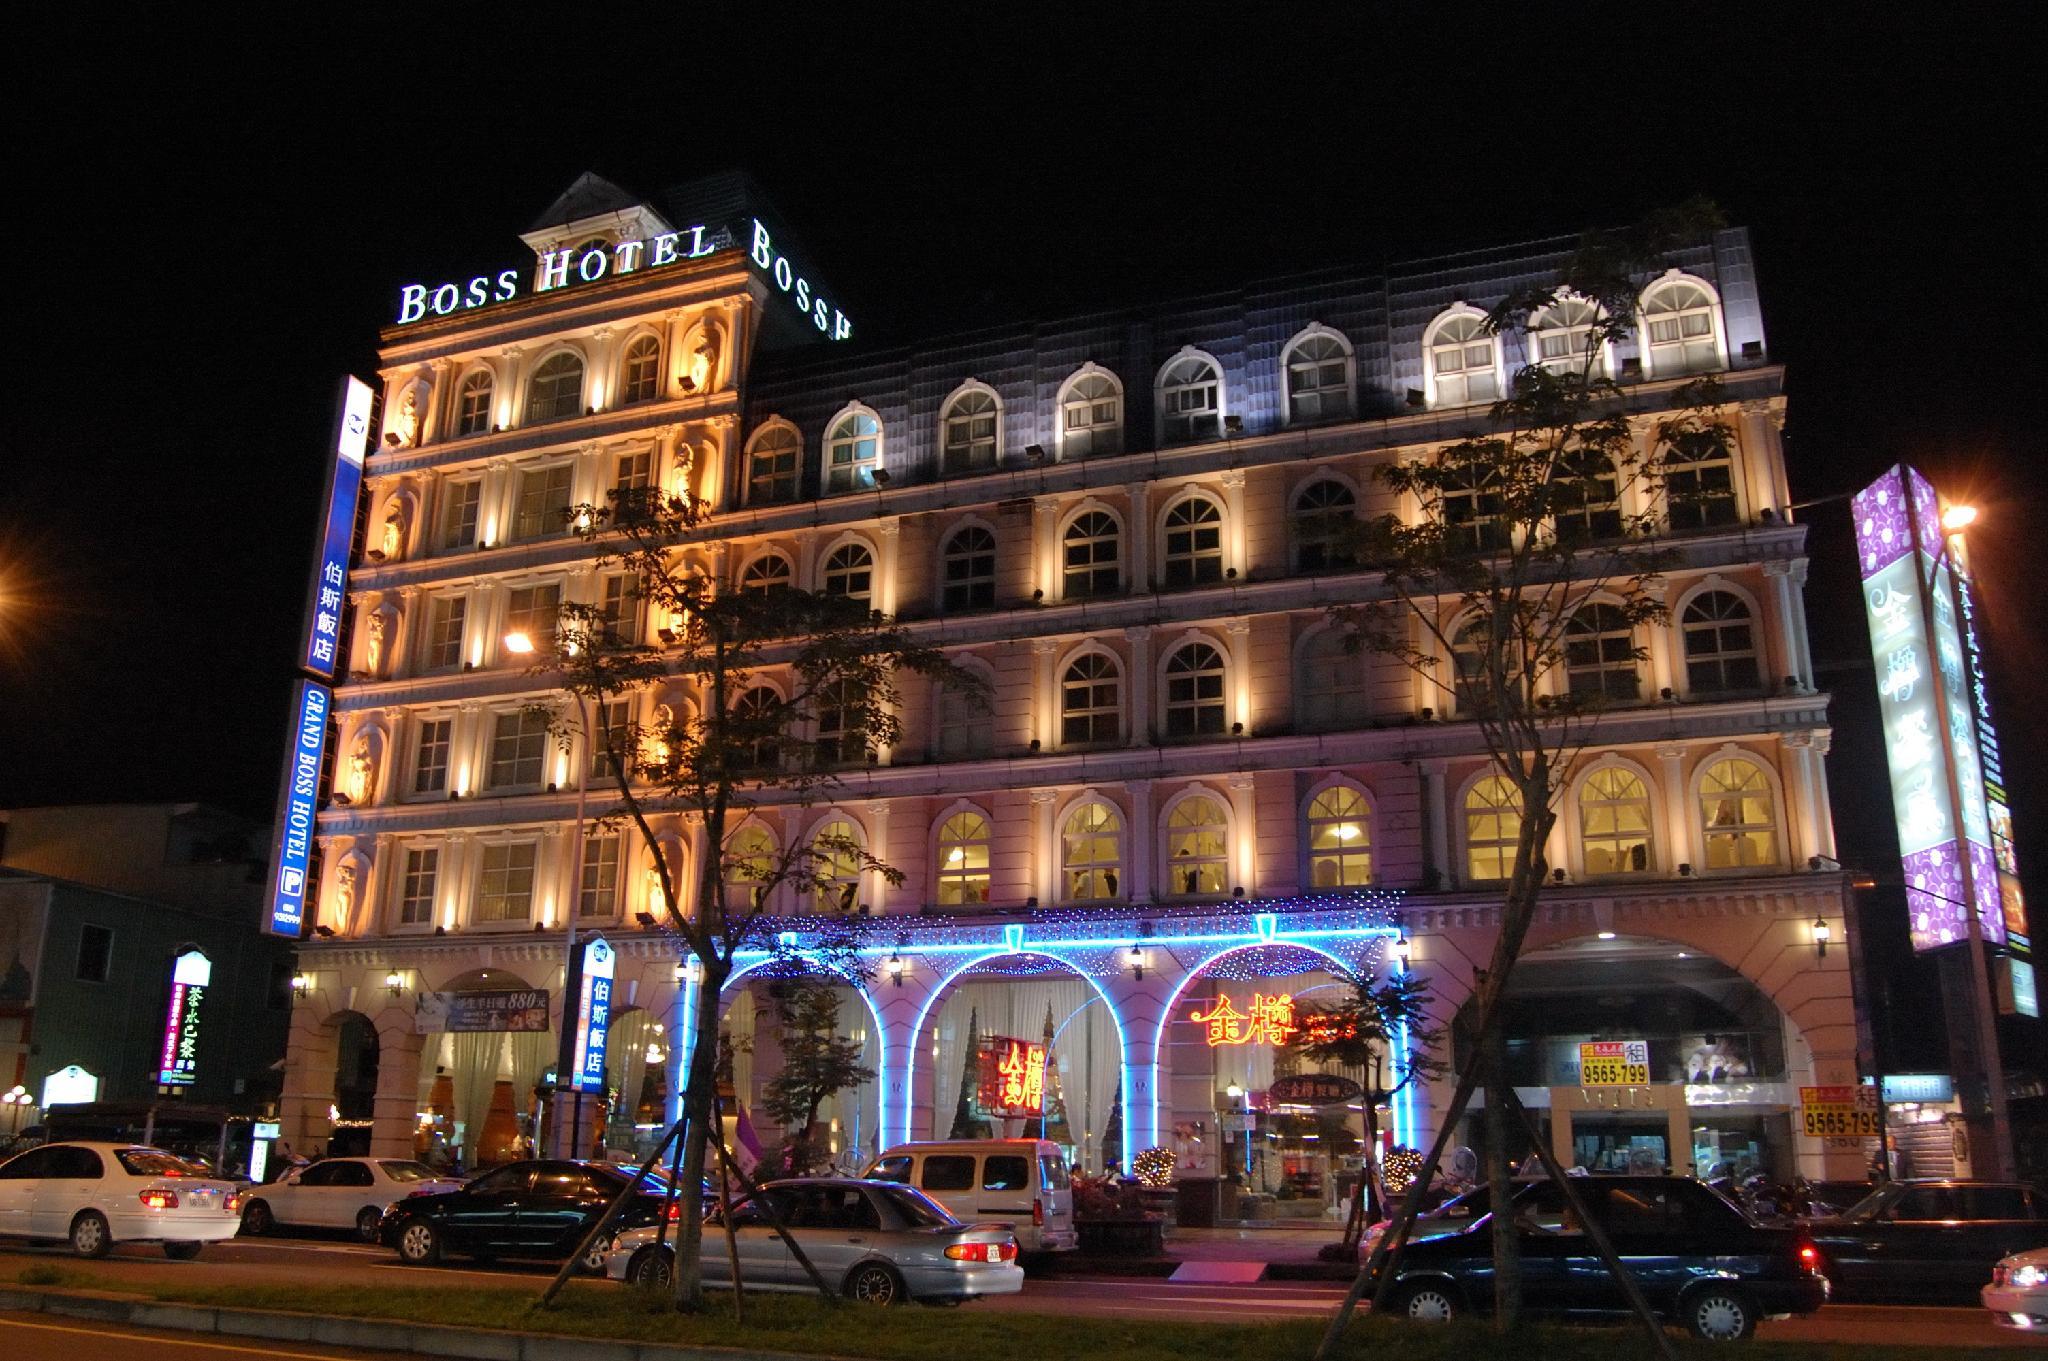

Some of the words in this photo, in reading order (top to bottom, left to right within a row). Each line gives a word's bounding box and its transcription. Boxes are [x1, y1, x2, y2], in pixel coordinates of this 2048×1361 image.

[397, 270, 518, 324] BOSS
[541, 226, 715, 292] HOTEL
[752, 218, 828, 332] BOSS
[312, 560, 343, 663] 伯斯飯店
[301, 689, 326, 749] GRAND
[294, 752, 317, 797] BOSS
[286, 799, 311, 859] HOTEL
[585, 979, 610, 1073] 伯斯飯店
[1191, 992, 1299, 1047] 金樽
[1625, 1043, 1647, 1063] 租
